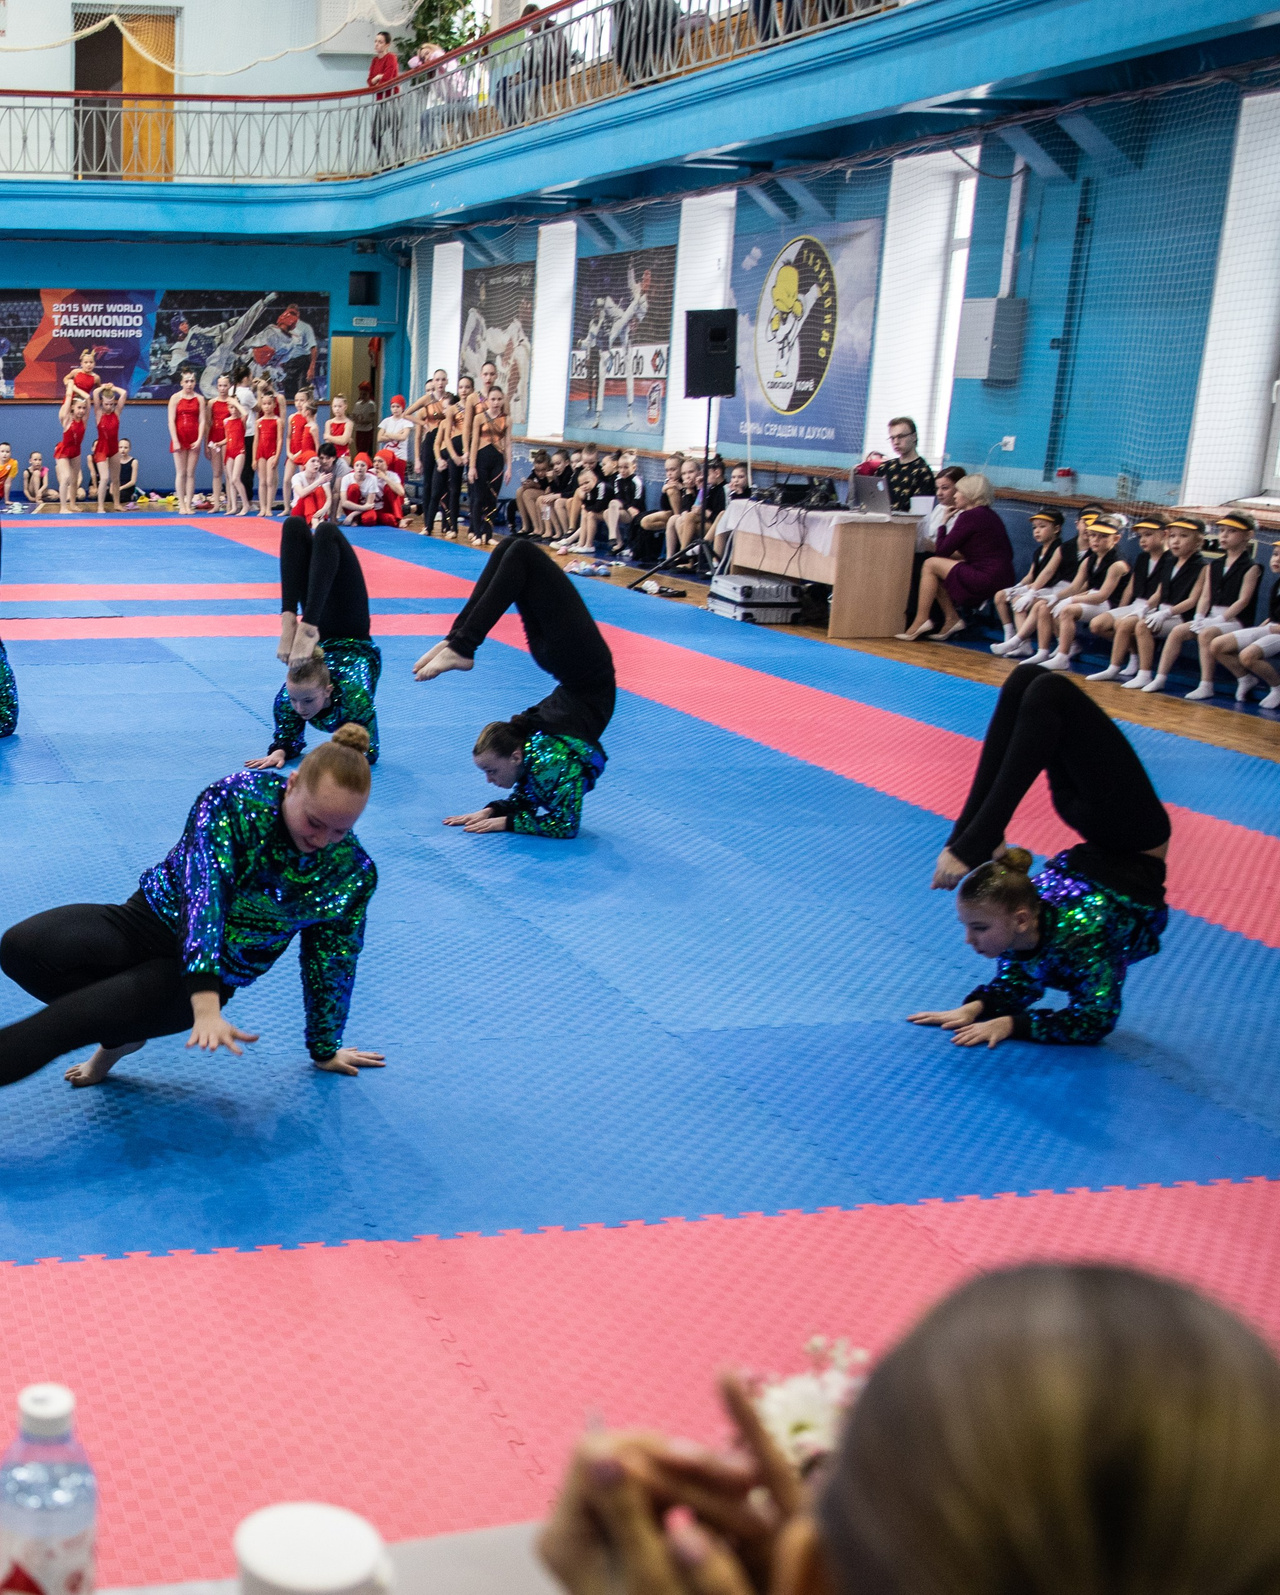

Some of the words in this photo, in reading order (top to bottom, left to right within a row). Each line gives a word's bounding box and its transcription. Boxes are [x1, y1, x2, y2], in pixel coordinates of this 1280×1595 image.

[52, 304, 79, 312] 2015
[82, 304, 104, 312] WTF
[106, 304, 143, 312] WORLD
[52, 315, 143, 326] TAEKWONDO
[52, 329, 143, 338] CHAMPIONSHIPS
